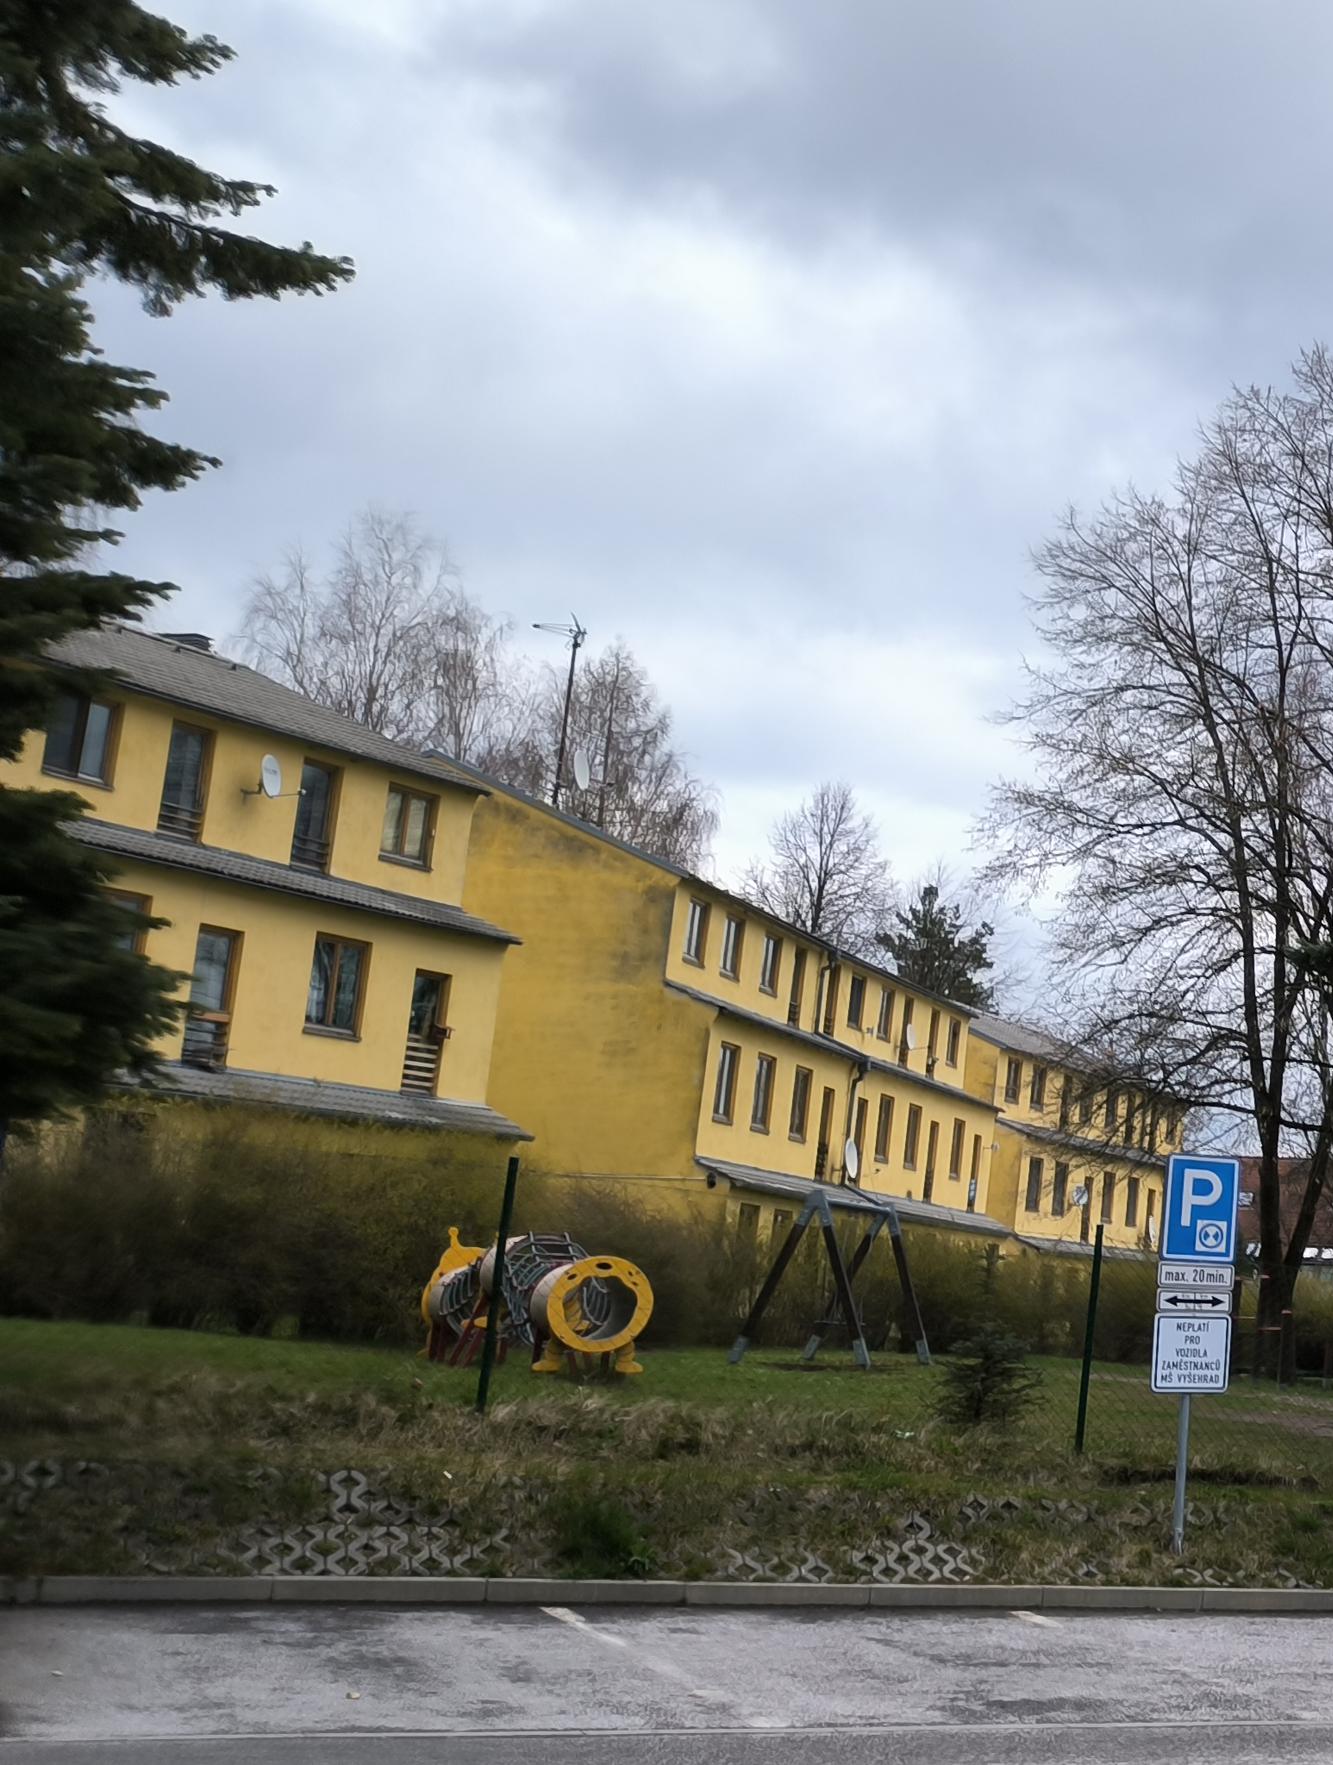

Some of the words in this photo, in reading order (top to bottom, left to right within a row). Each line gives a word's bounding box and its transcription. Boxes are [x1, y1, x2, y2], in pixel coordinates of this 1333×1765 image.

[1181, 1168, 1223, 1227] P
[1164, 1270, 1188, 1282] max.
[1176, 1321, 1210, 1332] NEPLATÍ
[1184, 1335, 1201, 1345] PRO
[1175, 1347, 1208, 1358] VOZIDLA
[1161, 1358, 1221, 1371] ZAMĚSTNANCŮ
[1160, 1371, 1174, 1383] MŠ
[1177, 1371, 1220, 1384] VYŠEHRAD
